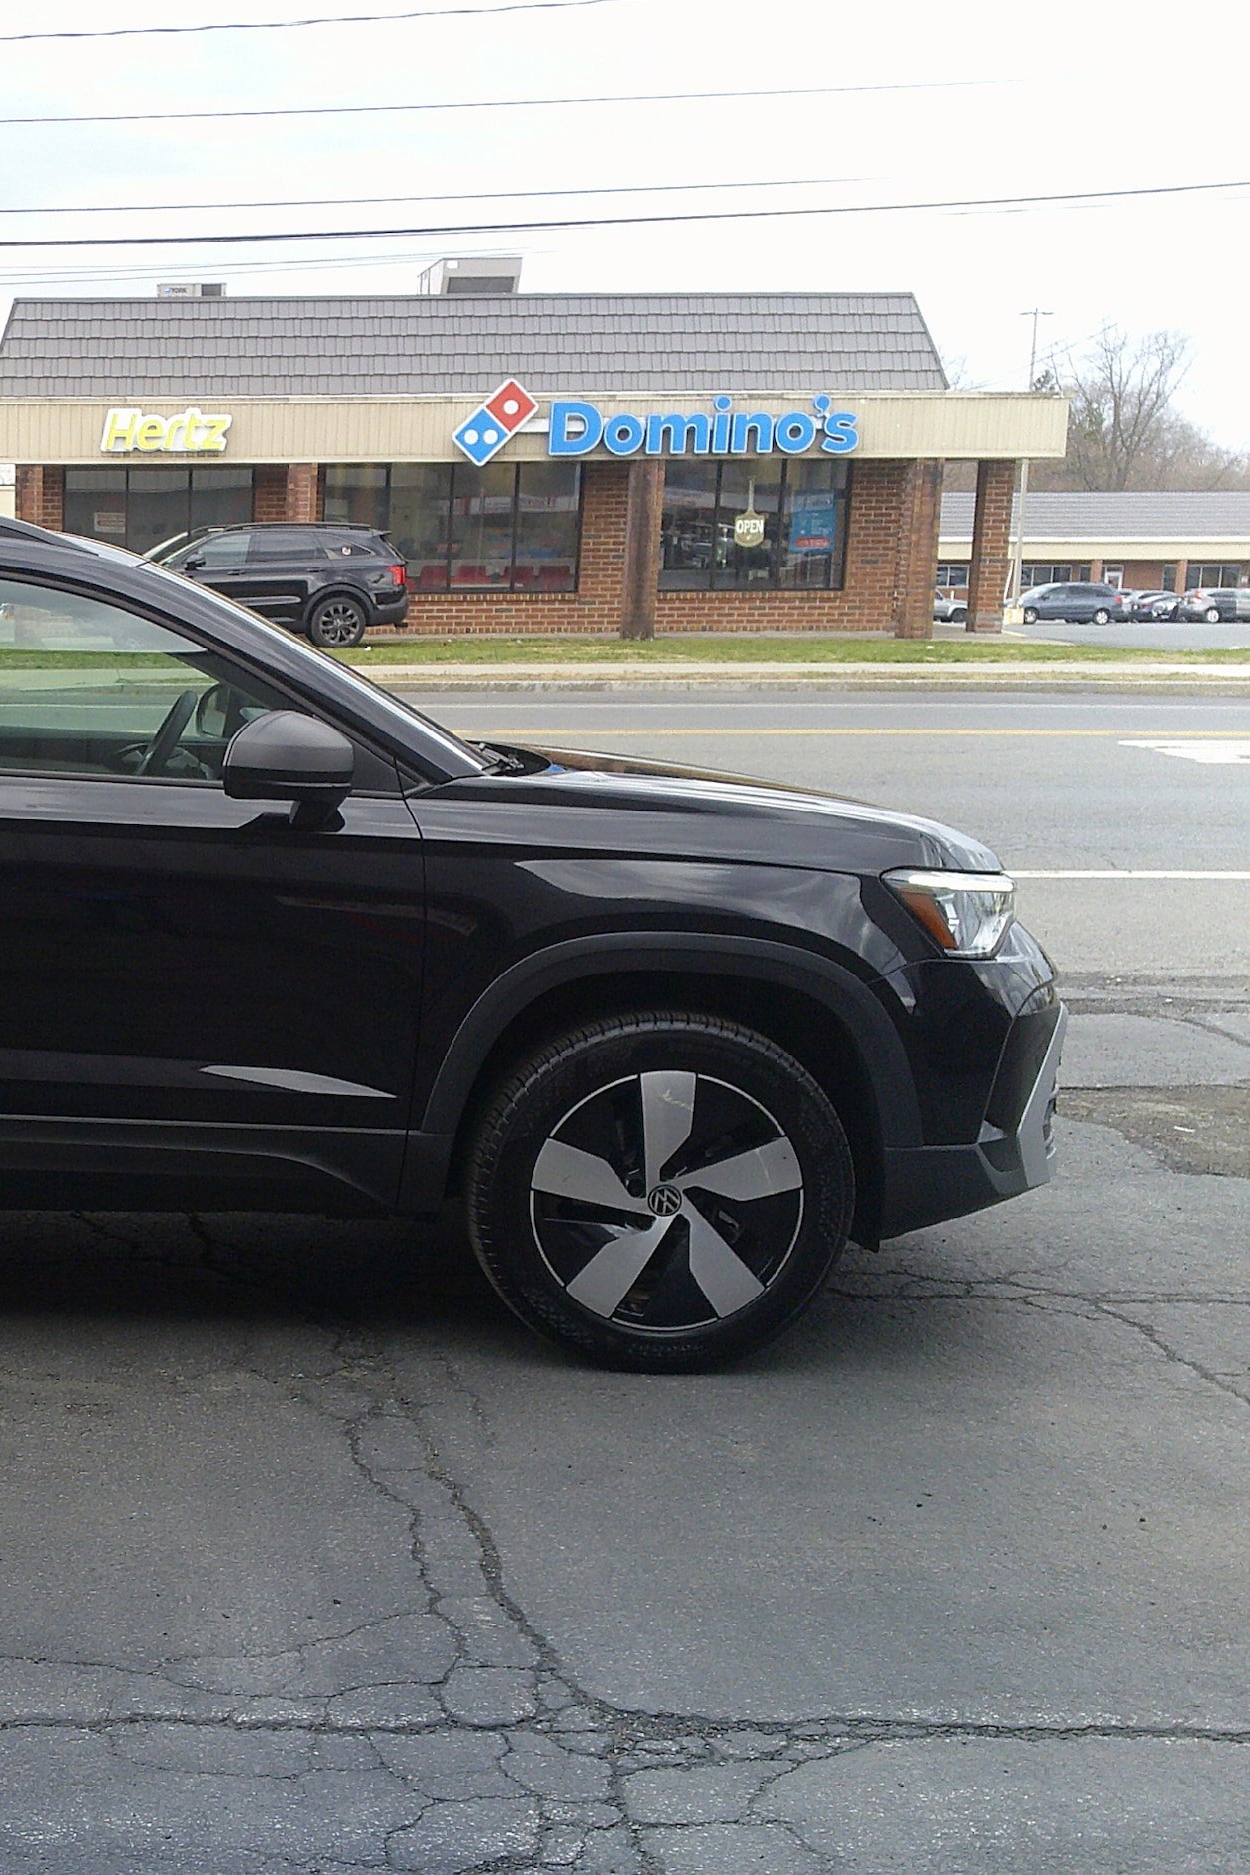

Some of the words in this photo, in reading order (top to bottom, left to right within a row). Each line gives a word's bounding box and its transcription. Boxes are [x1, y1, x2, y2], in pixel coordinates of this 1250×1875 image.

[104, 410, 229, 451] Hertz
[549, 395, 859, 455] Domino's
[736, 519, 764, 533] OPEN
